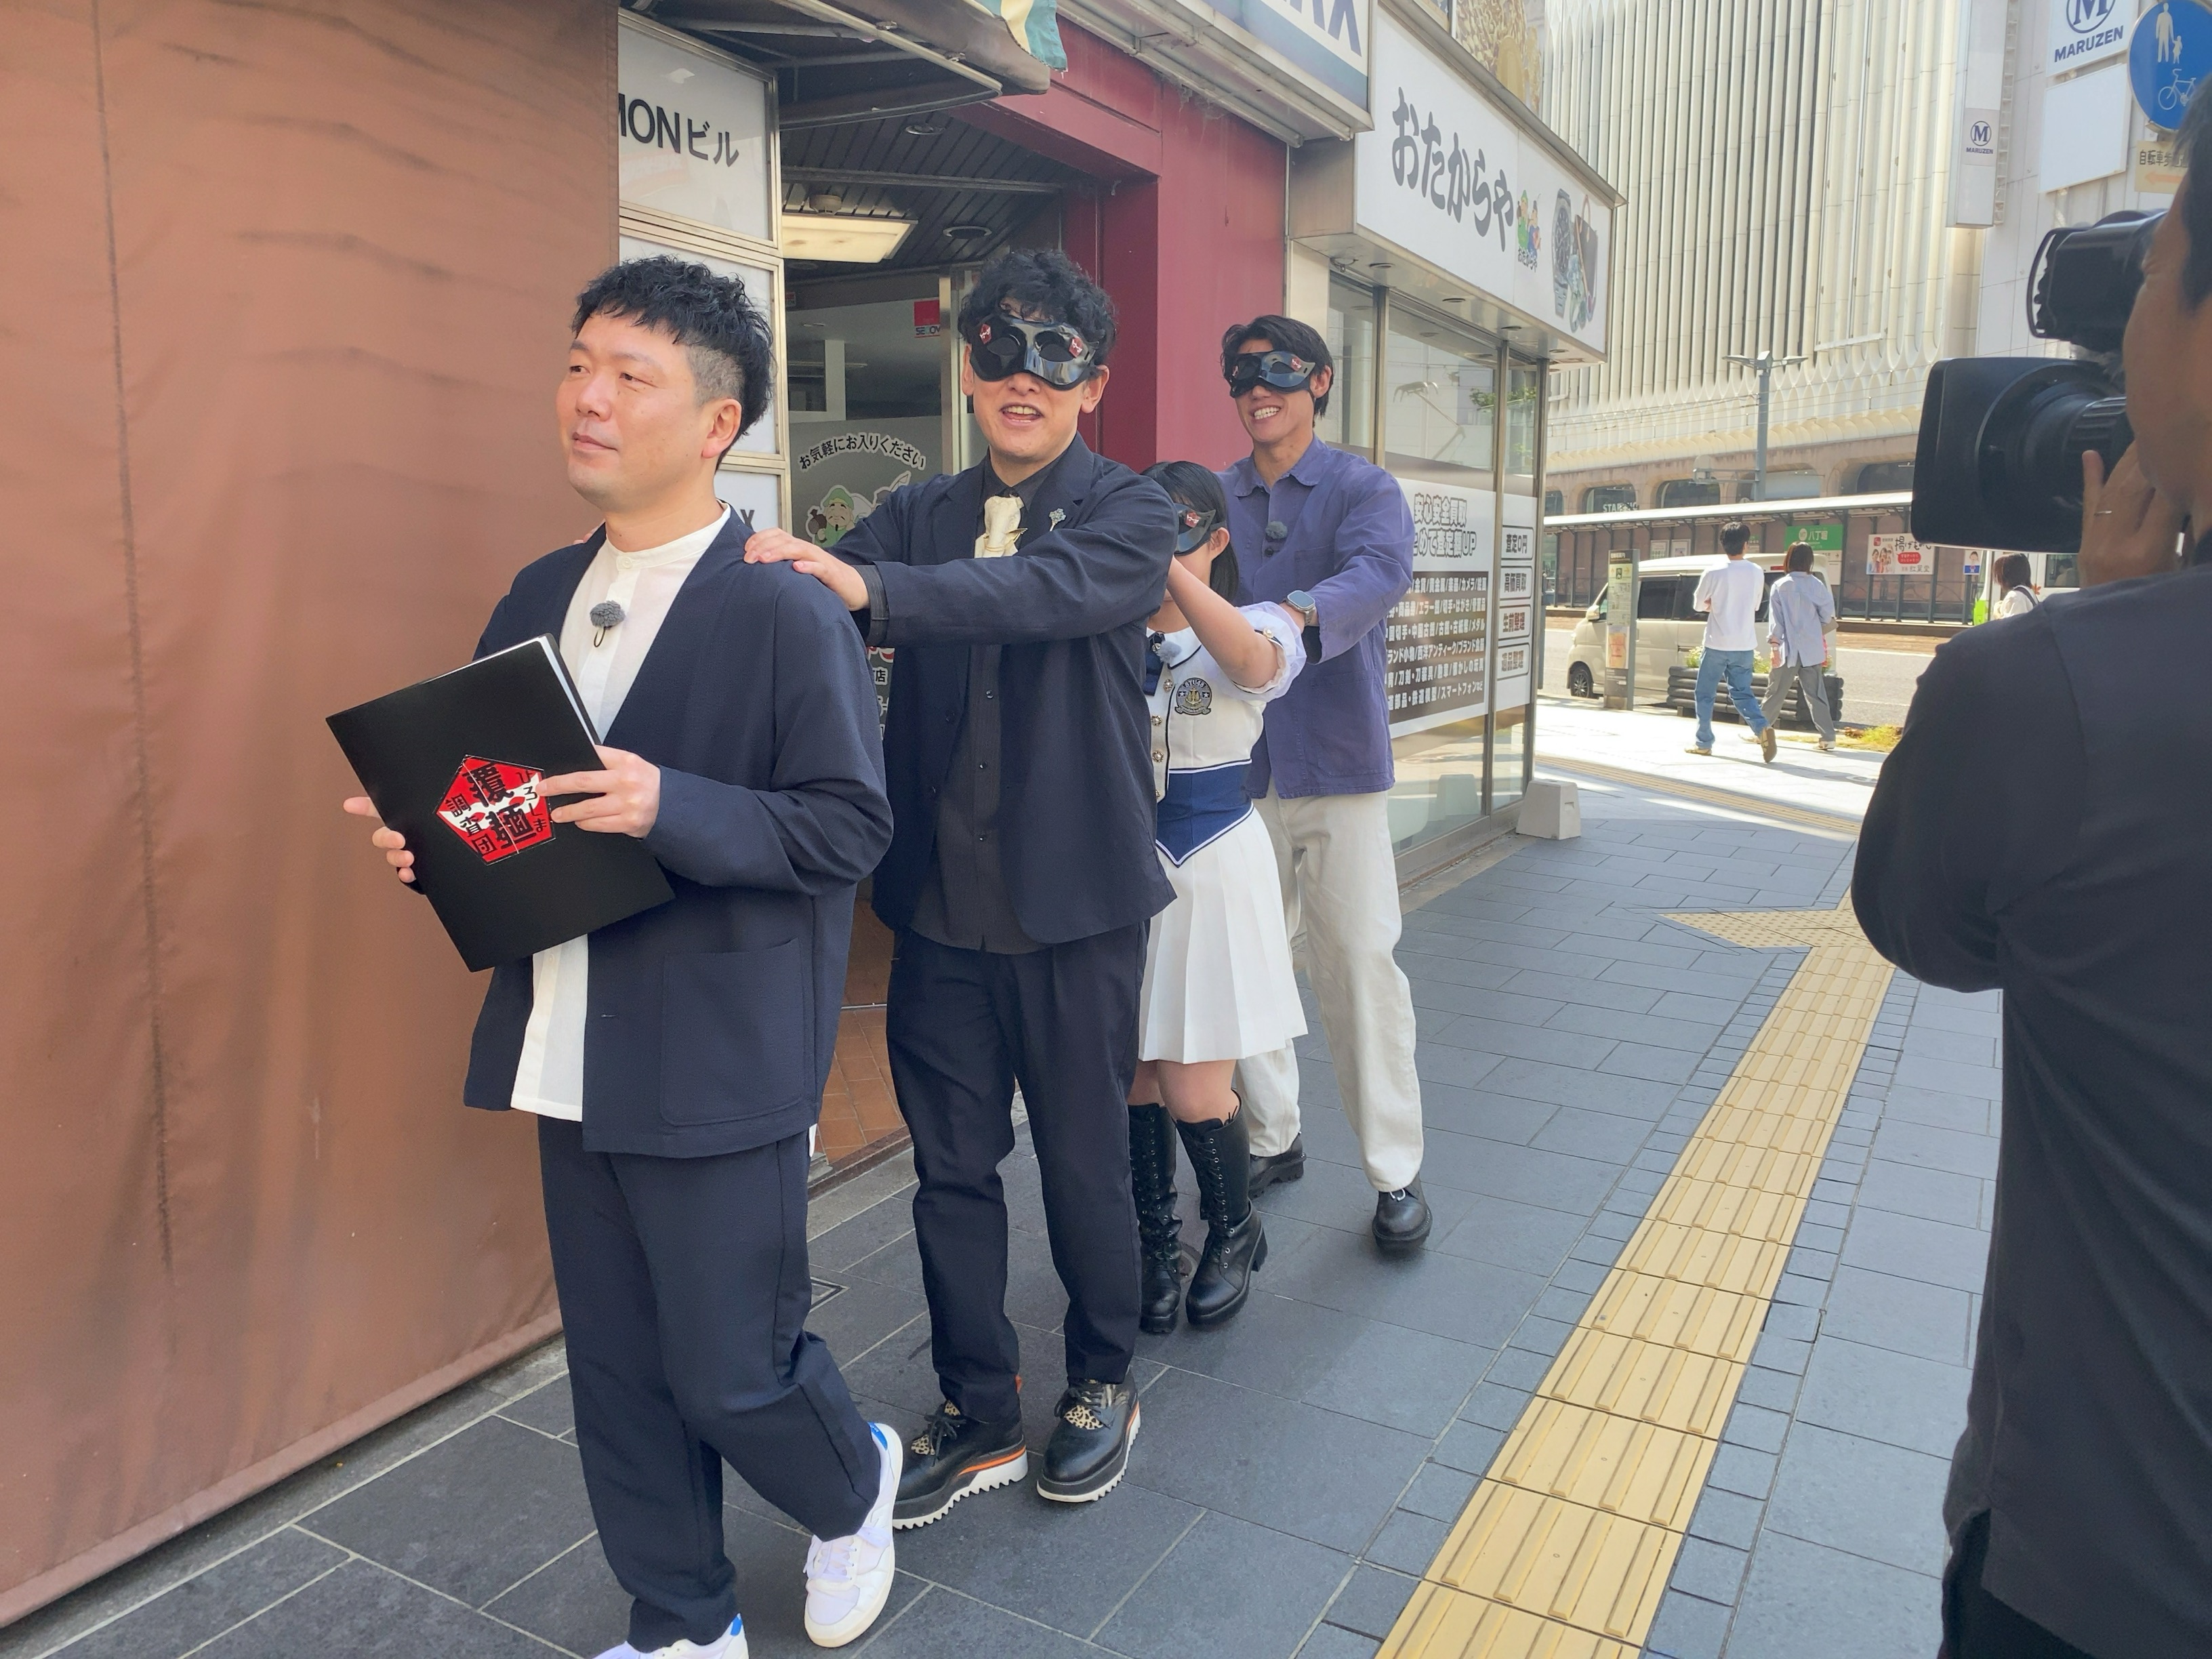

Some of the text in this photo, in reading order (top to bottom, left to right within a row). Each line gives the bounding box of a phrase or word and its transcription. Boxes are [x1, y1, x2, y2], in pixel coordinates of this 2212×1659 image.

[2054, 25, 2124, 62] MARUZEN
[1973, 125, 1989, 142] M
[1392, 87, 1514, 252] おたからや
[1518, 248, 1538, 272] おたからや
[799, 434, 924, 470] お気軽にお入りください
[1414, 493, 1467, 528] 安心安全買取
[1504, 573, 1526, 592] 高価買取
[516, 771, 547, 832] ひろしま
[445, 794, 497, 856] 調査団
